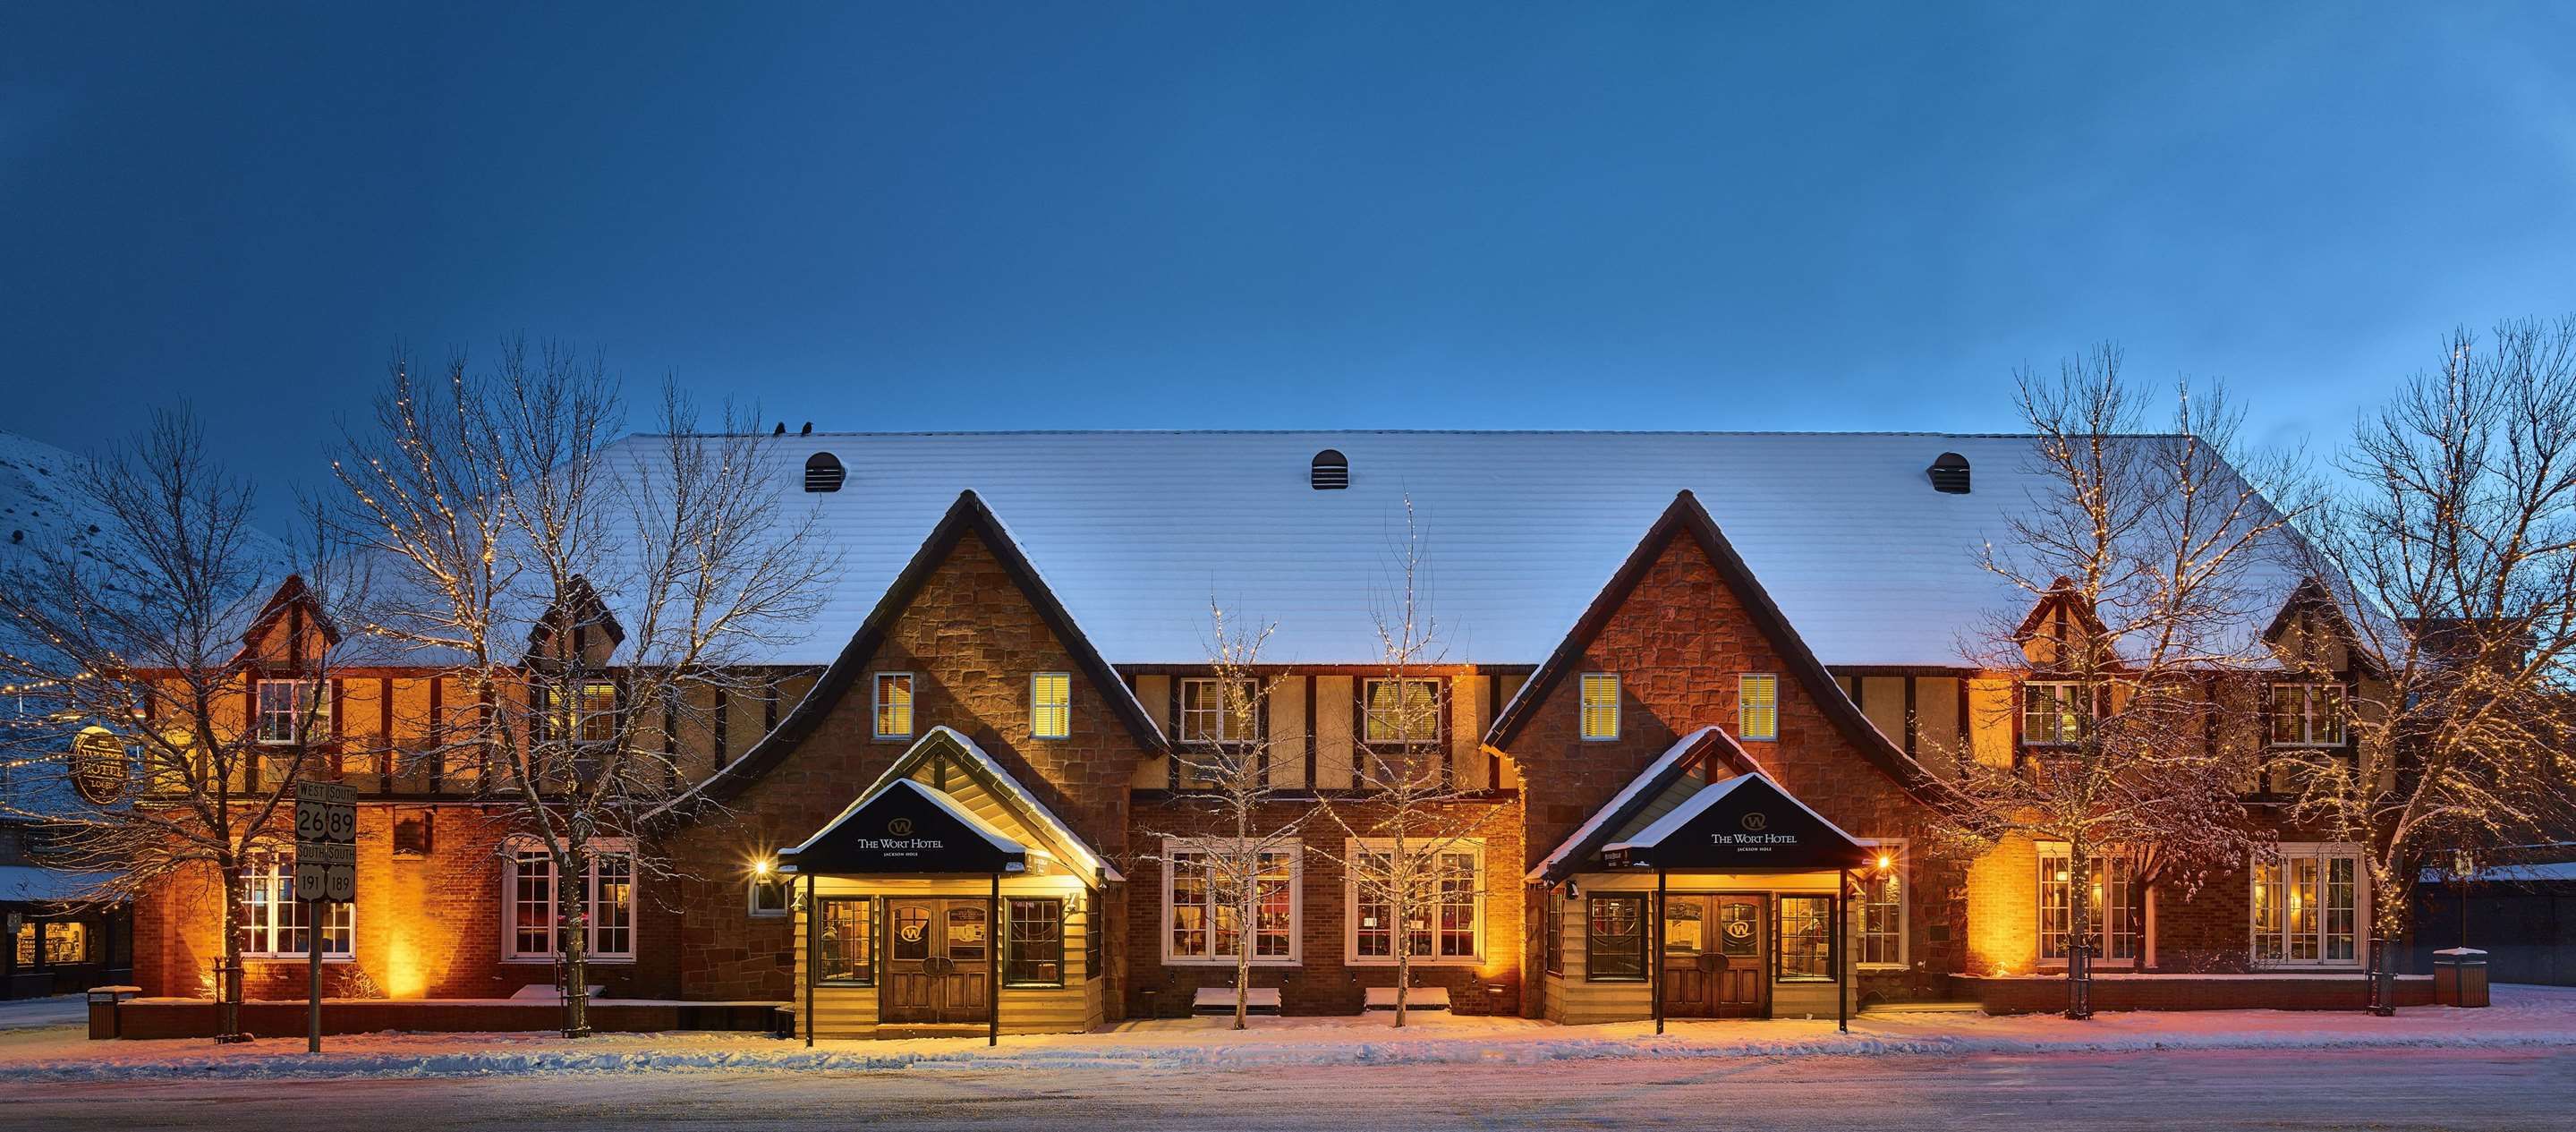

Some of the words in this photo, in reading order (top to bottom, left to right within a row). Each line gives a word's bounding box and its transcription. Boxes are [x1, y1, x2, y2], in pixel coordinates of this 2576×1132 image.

[300, 782, 324, 796] WEST
[329, 787, 357, 801] SOUTH
[299, 809, 323, 831] 26
[331, 813, 353, 833] 89
[858, 838, 879, 848] THE
[880, 838, 909, 848] WORT
[911, 838, 943, 848] HOTEL
[1711, 834, 1732, 843] THE
[1733, 834, 1763, 843] WORT
[1764, 834, 1797, 843] HOTEL
[298, 844, 324, 858] SOUTH
[328, 847, 353, 860] SOUTH
[302, 875, 319, 890] 191
[332, 876, 350, 891] 189
